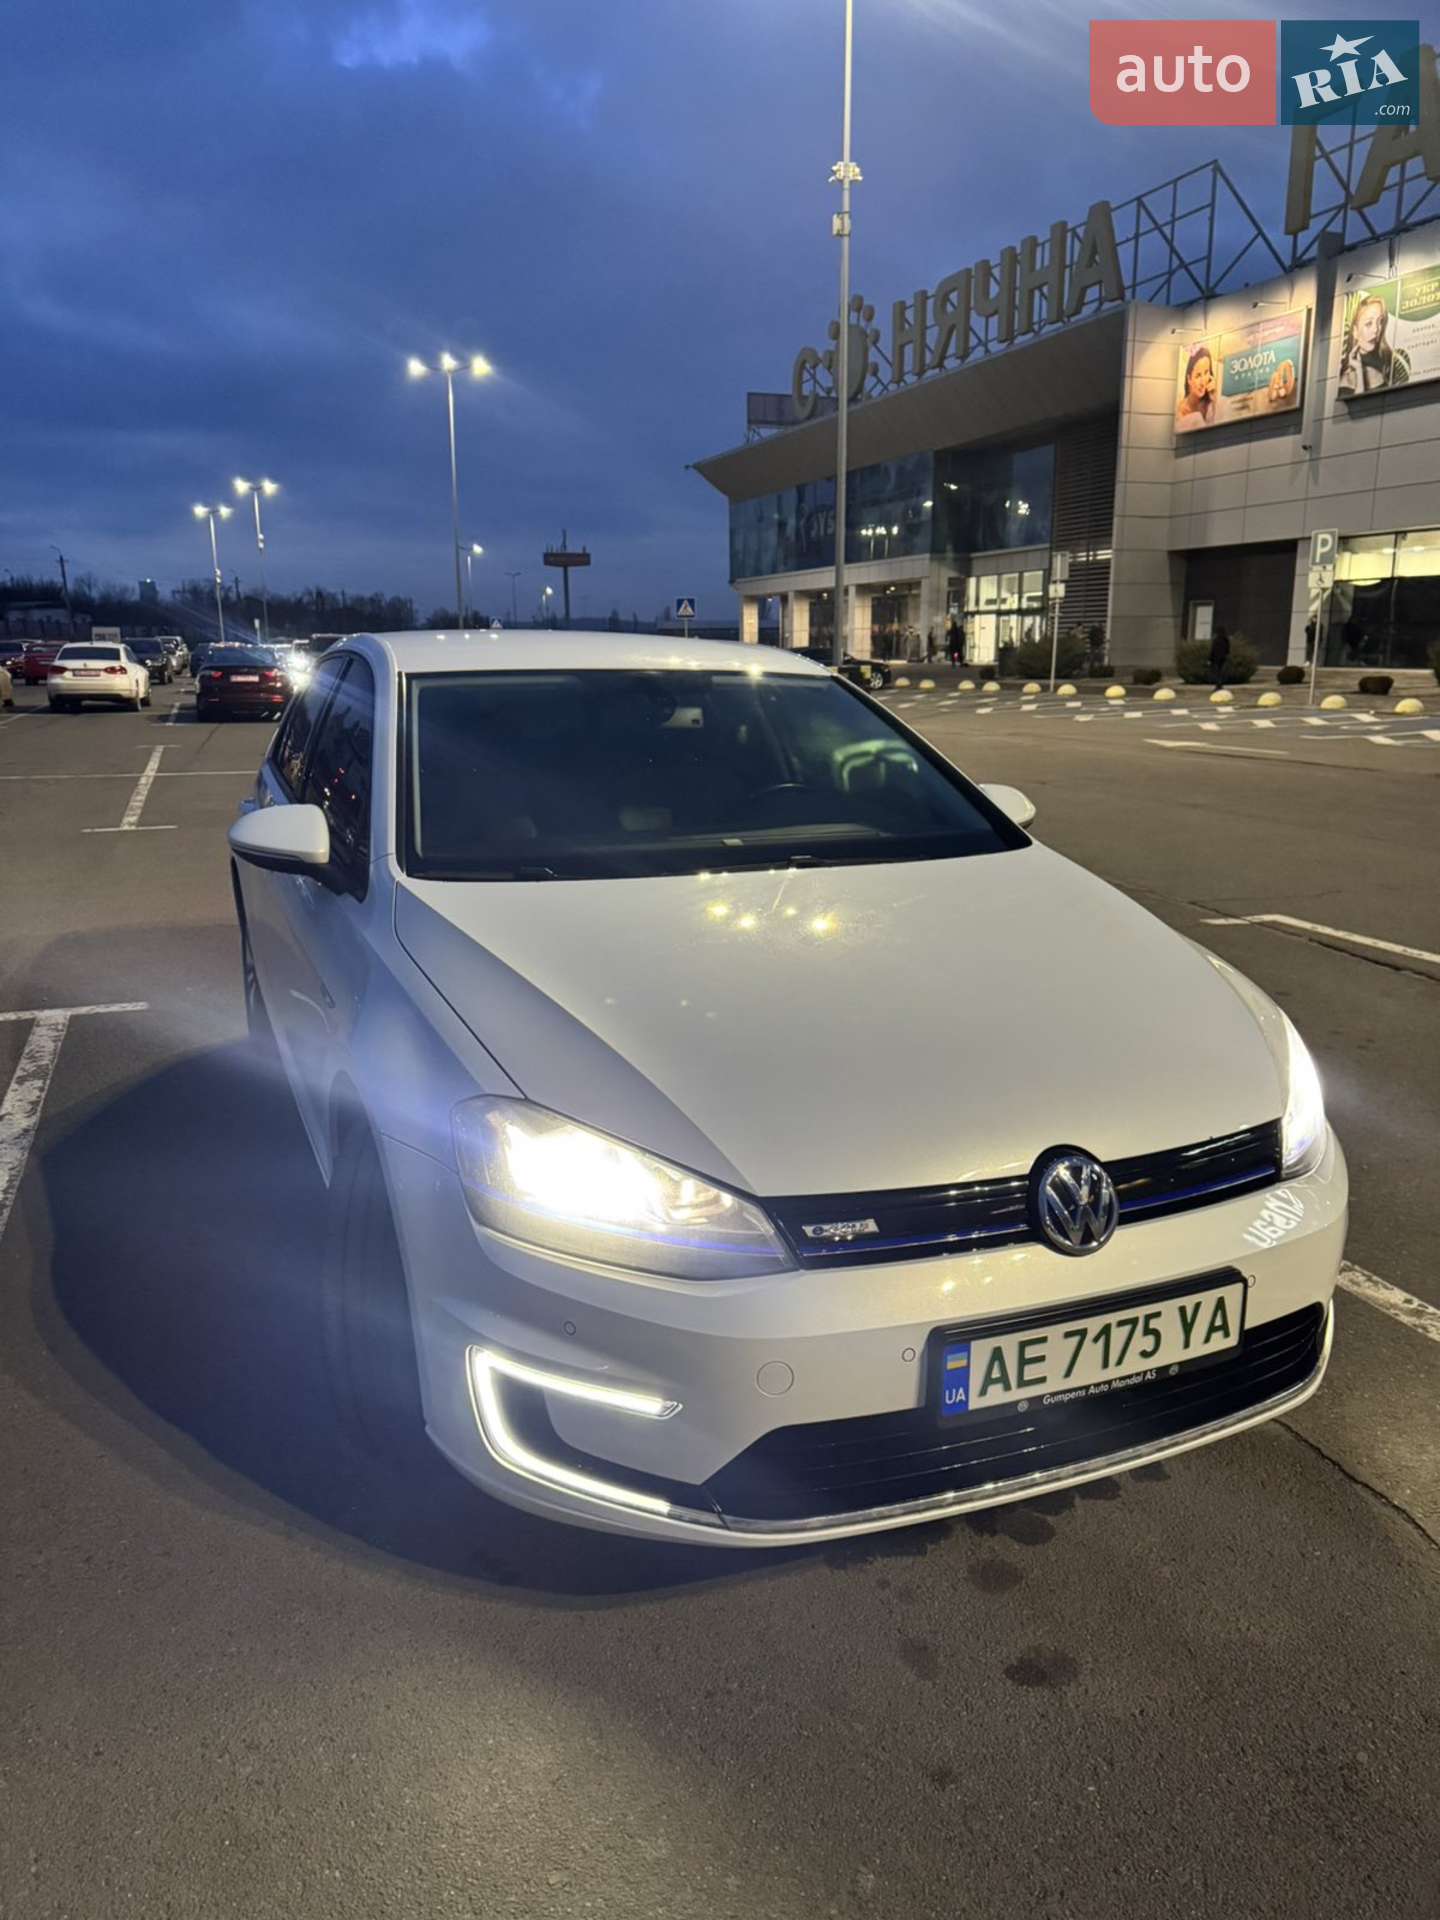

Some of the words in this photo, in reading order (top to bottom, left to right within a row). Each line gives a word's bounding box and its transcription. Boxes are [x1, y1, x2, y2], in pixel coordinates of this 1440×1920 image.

[1230, 349, 1276, 374] ЗОЛОТА
[1315, 533, 1333, 563] P
[977, 1335, 1049, 1398] AE
[1062, 1310, 1163, 1379] 7175
[1177, 1295, 1232, 1350] YA
[944, 1387, 966, 1405] UA
[1042, 1386, 1087, 1406] Gumpens
[1087, 1383, 1109, 1396] Auto
[1110, 1373, 1144, 1391] Mandal
[1144, 1369, 1158, 1381] AS
